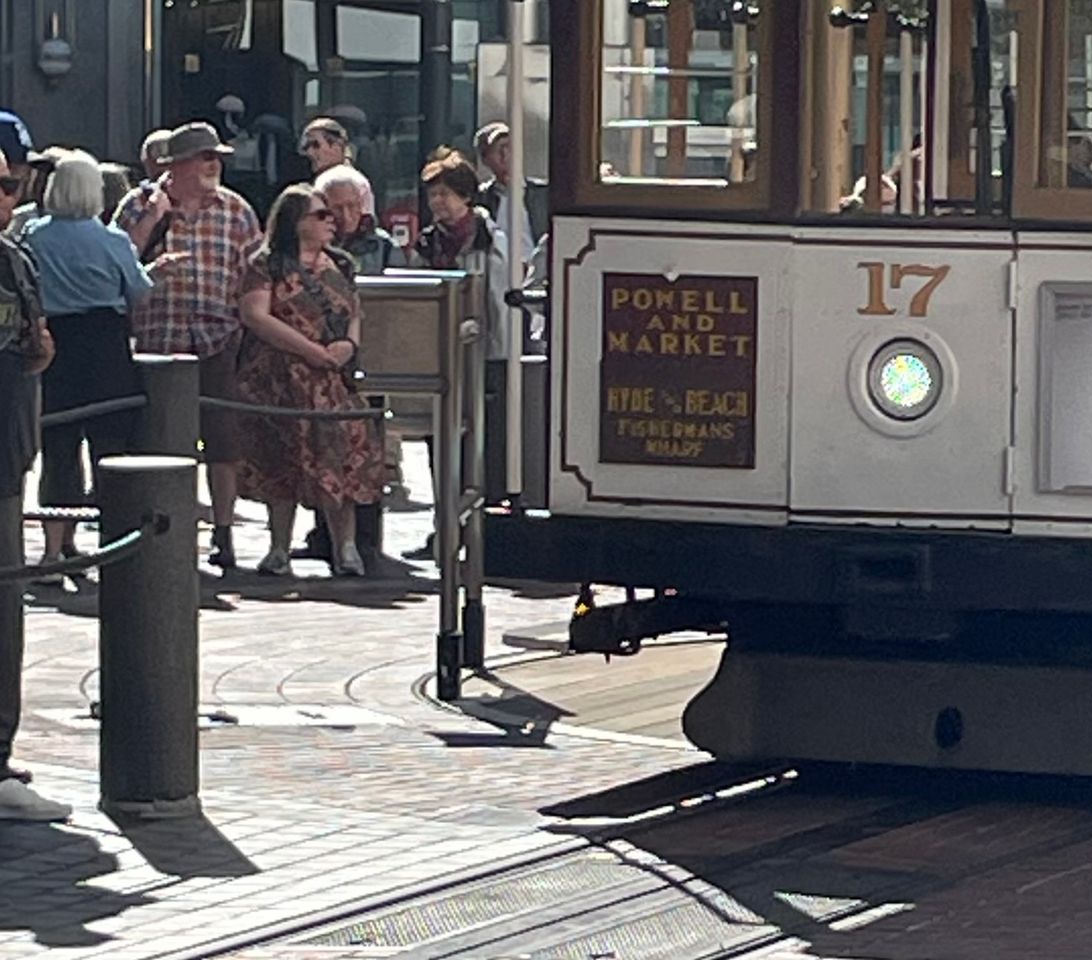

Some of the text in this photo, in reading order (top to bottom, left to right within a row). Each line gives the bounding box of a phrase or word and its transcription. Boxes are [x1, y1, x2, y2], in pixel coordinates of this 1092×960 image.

[611, 288, 749, 314] POWELL
[856, 262, 951, 317] 17
[647, 314, 715, 332] AND
[608, 331, 752, 357] MARKET
[607, 387, 655, 413] HYDE
[685, 389, 747, 416] BEACH
